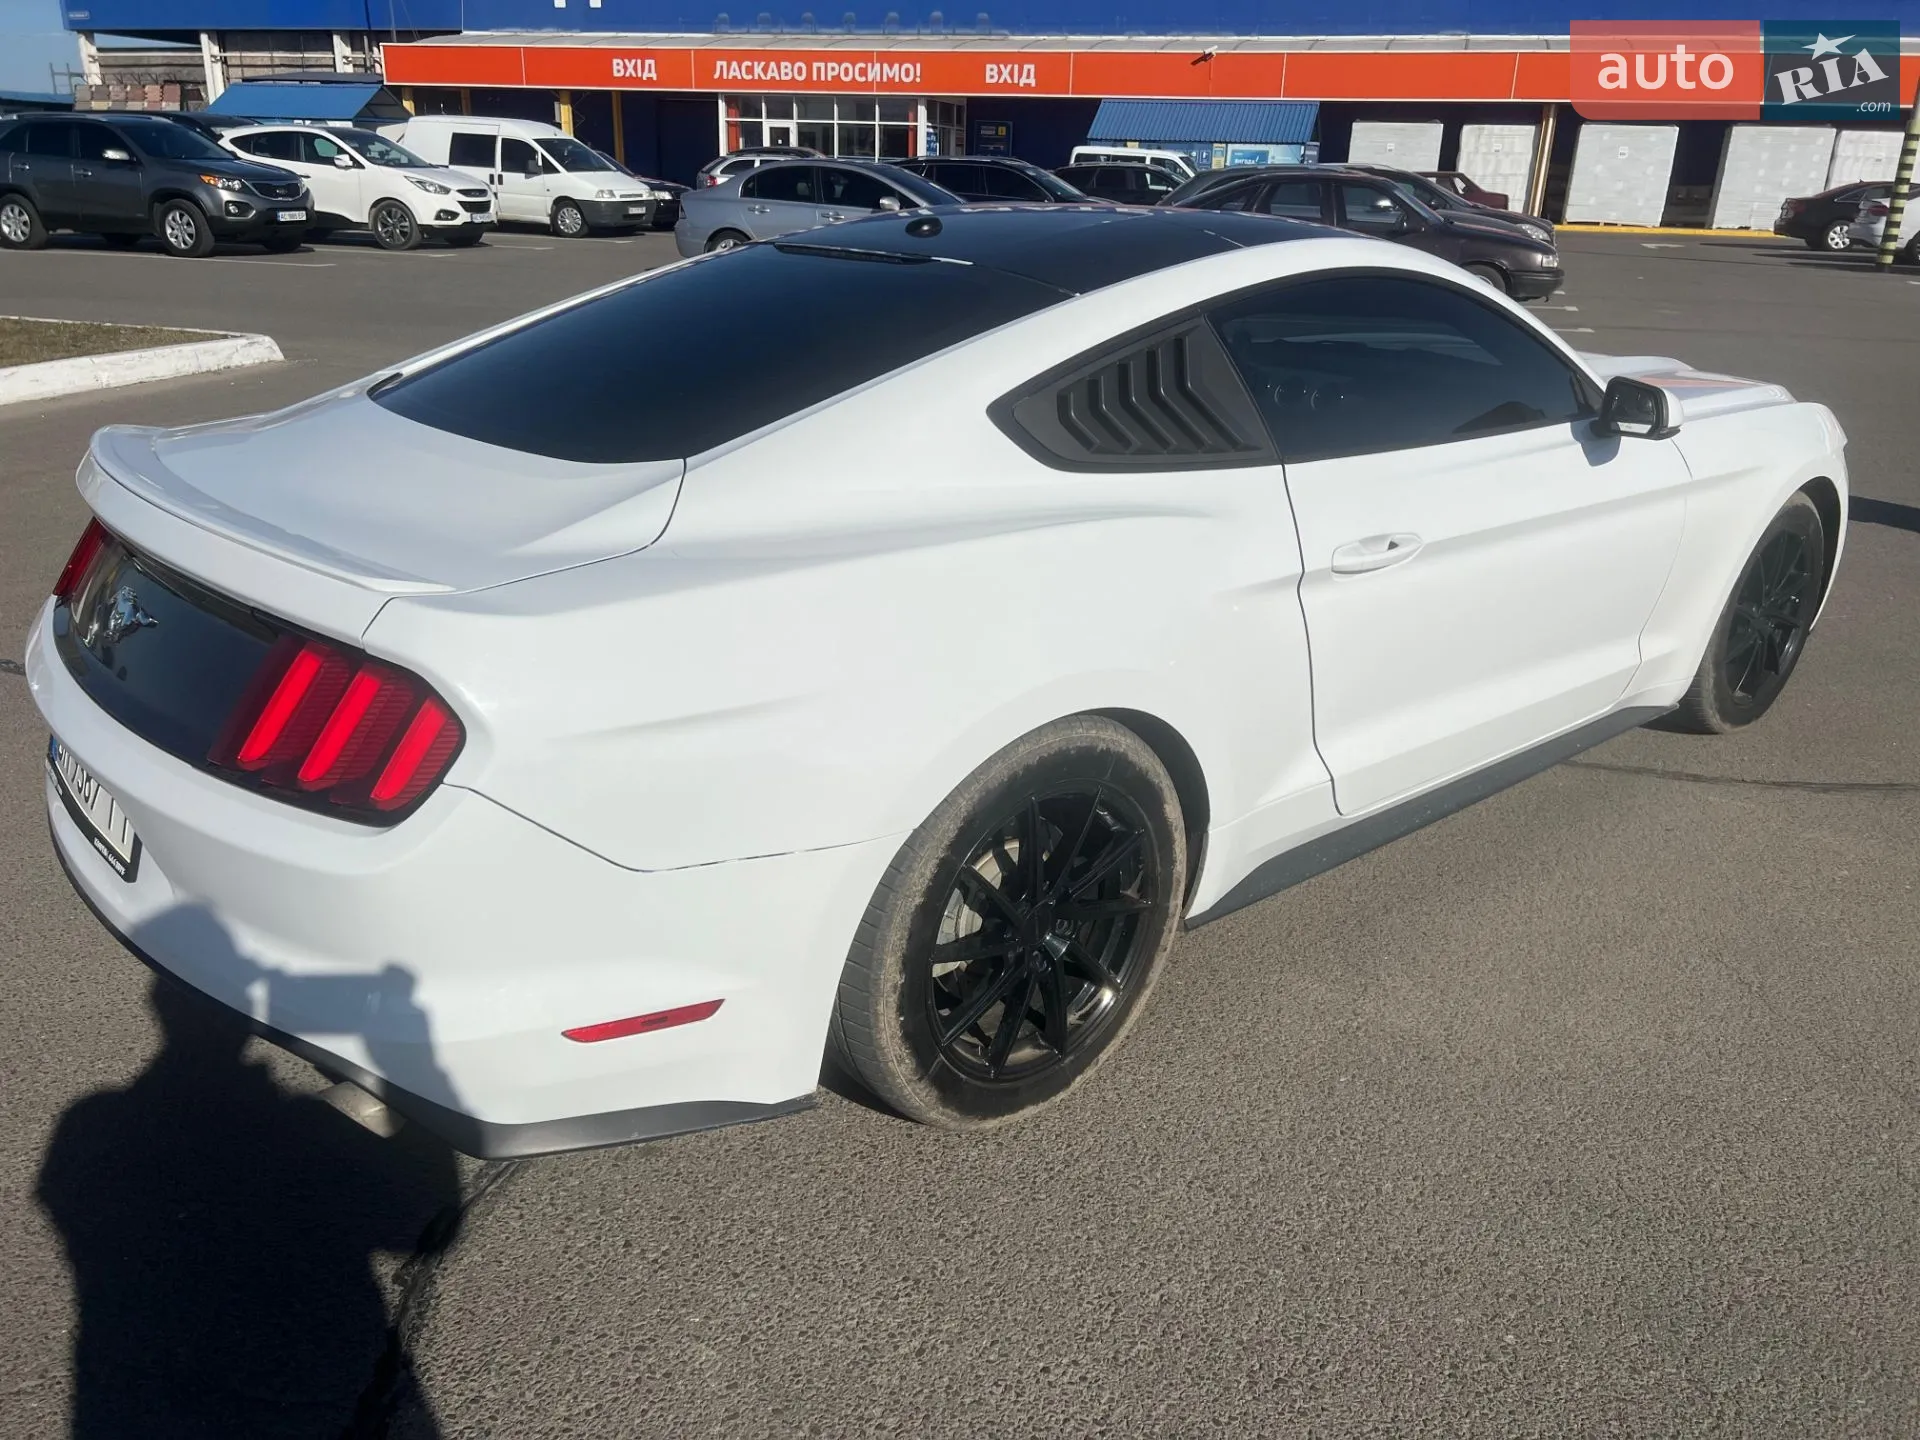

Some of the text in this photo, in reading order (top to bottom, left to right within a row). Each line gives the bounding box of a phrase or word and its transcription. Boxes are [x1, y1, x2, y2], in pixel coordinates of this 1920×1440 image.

[612, 58, 658, 81] ВХІД
[713, 60, 922, 83] ЛАСКАВО ПРОСИМО!
[985, 63, 1036, 87] ВХІД
